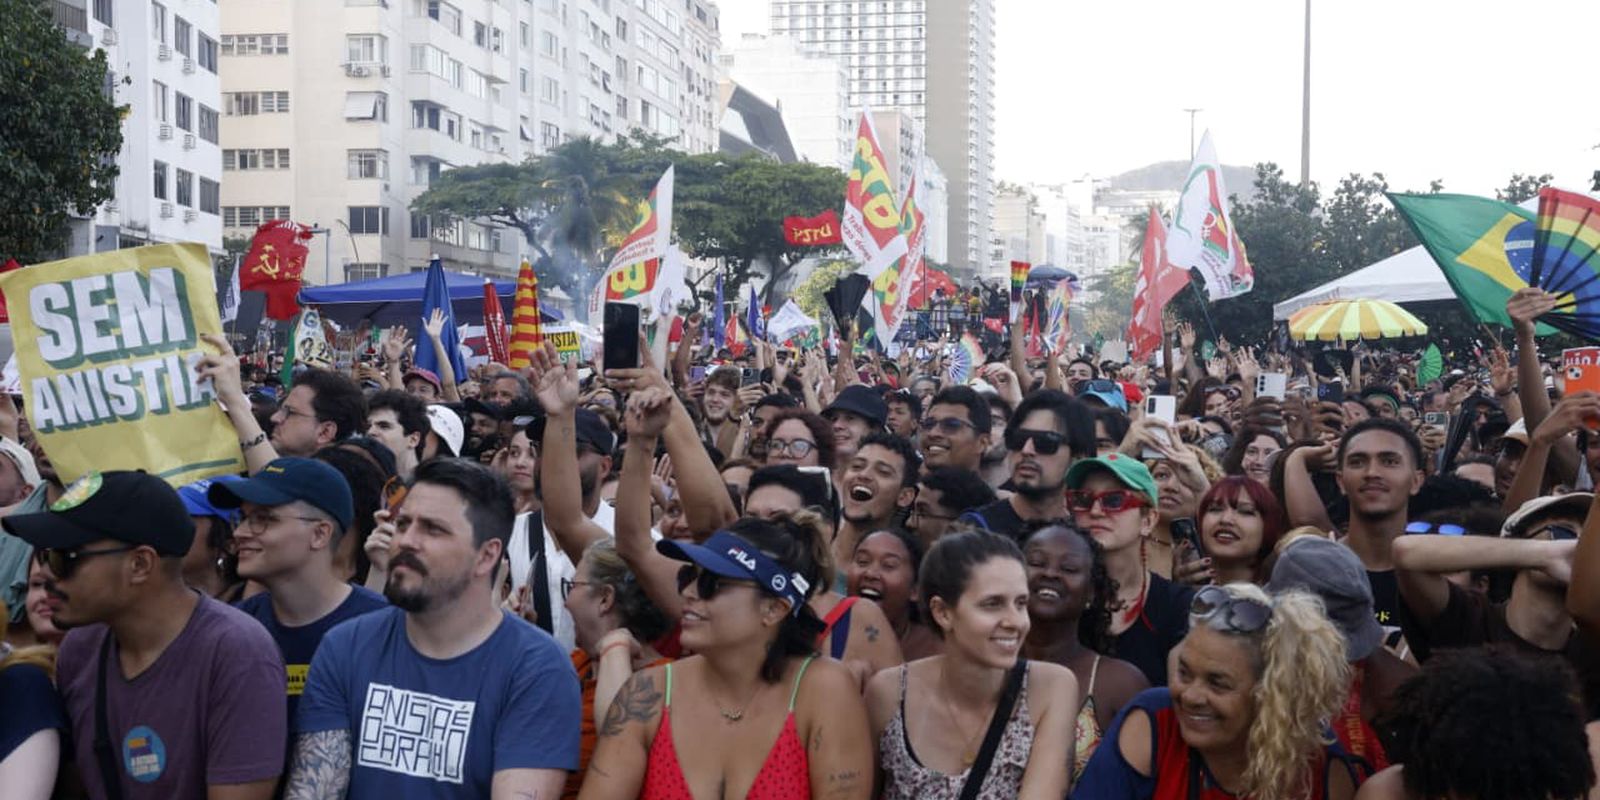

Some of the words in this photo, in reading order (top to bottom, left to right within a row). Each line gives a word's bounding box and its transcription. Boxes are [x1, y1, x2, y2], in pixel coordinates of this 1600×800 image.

[29, 266, 194, 367] SEM
[30, 351, 219, 431] ANISTIA
[727, 547, 757, 571] FILA
